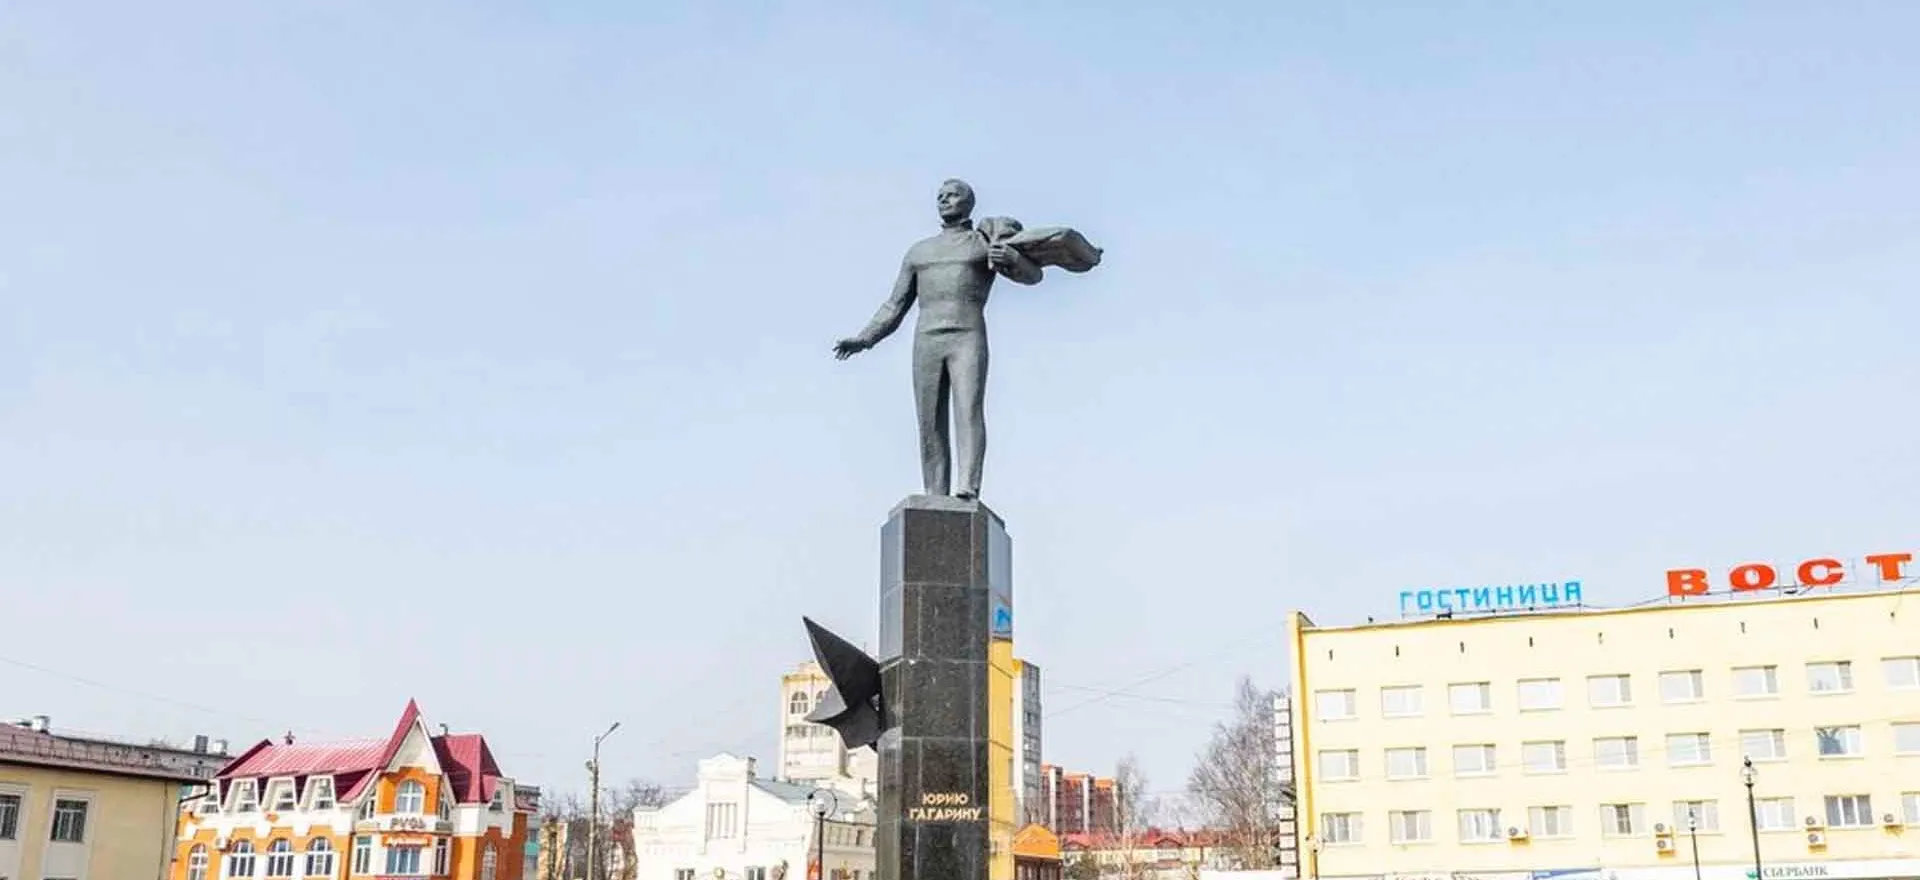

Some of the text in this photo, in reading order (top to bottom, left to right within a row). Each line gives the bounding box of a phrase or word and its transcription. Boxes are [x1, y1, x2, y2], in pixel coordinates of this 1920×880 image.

[1665, 553, 1913, 597] ВОСТ
[1399, 581, 1582, 612] ГОСТИНИЦА
[922, 792, 969, 805] ЮРИЮ
[909, 807, 981, 821] ГАГАРИНУ
